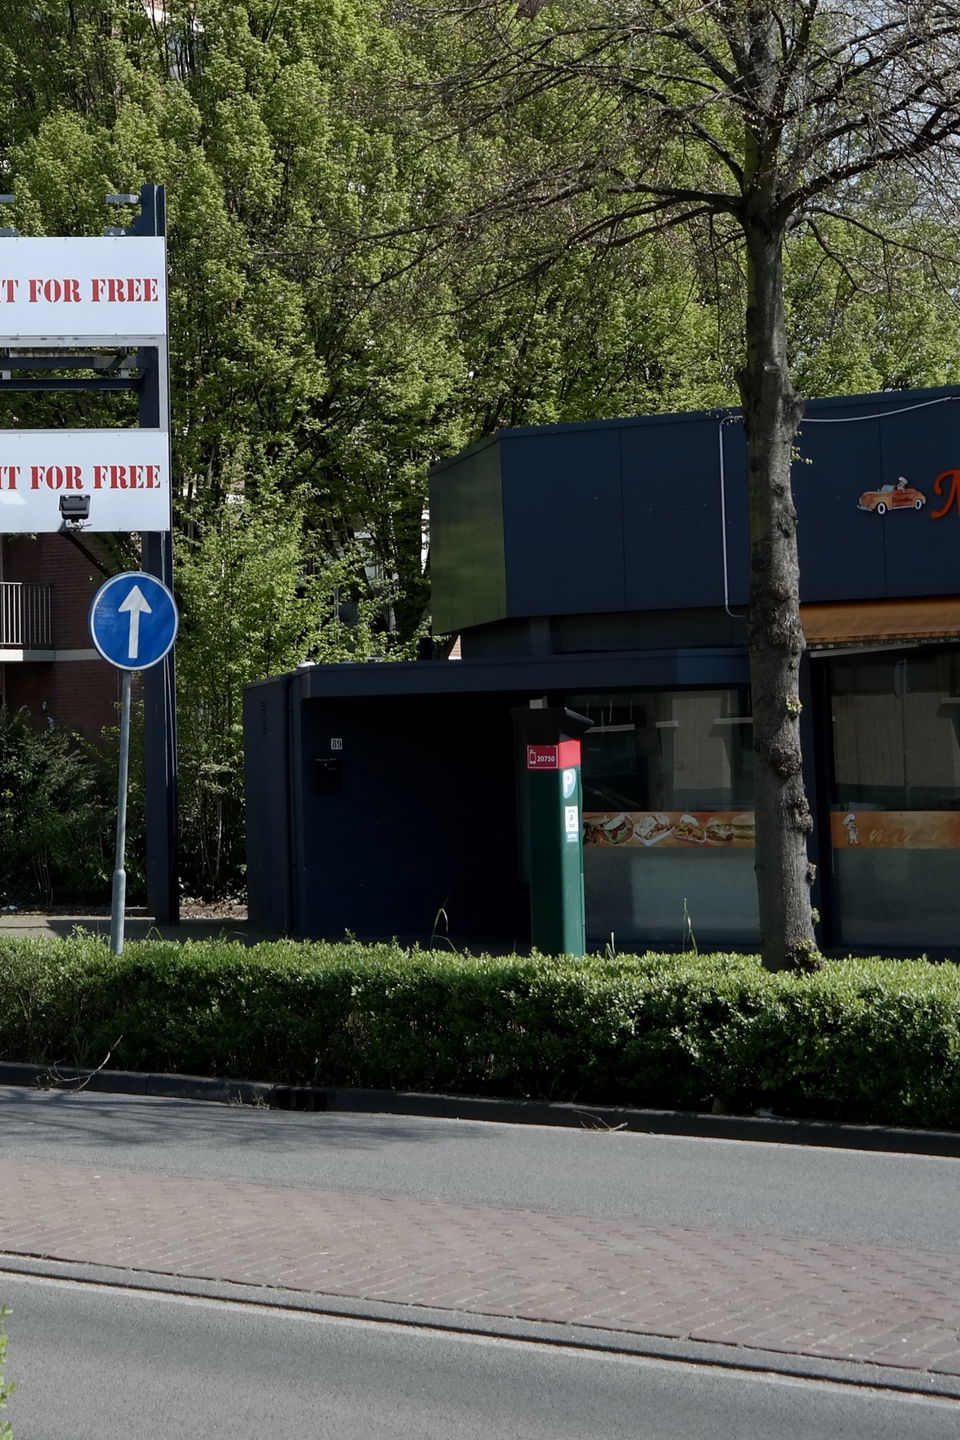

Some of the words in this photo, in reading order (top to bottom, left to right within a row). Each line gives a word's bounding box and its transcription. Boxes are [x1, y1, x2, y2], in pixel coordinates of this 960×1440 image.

[28, 279, 82, 303] FOR
[90, 278, 159, 302] FREE
[30, 465, 84, 490] FOR
[92, 465, 161, 489] FREE
[536, 755, 556, 763] 20750
